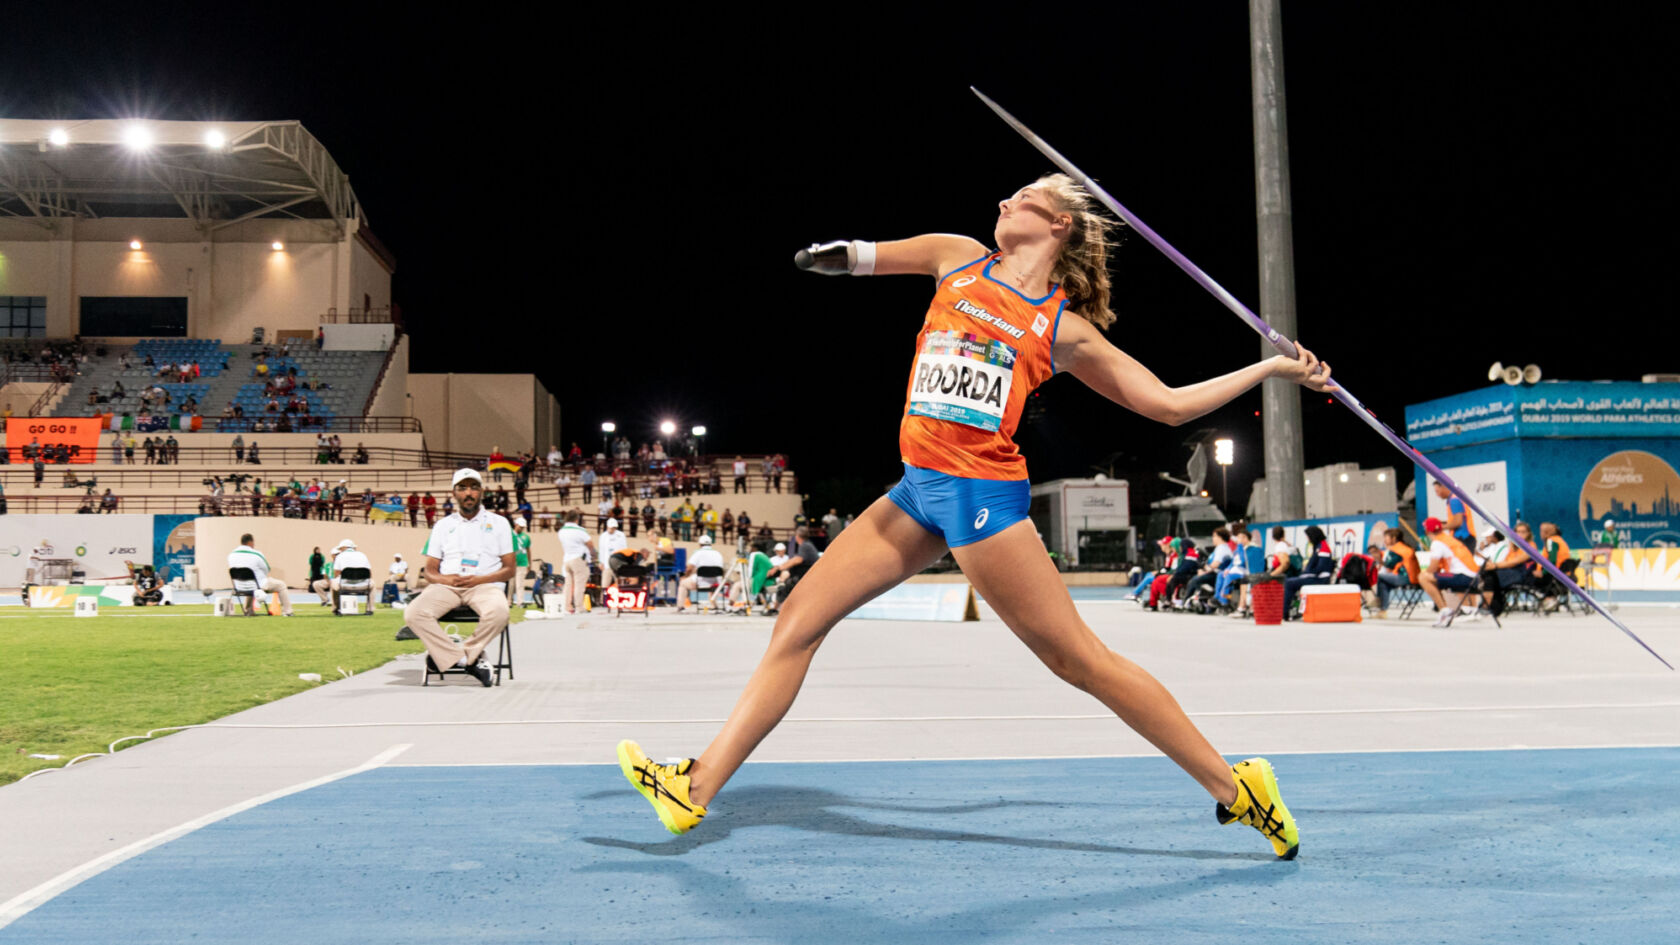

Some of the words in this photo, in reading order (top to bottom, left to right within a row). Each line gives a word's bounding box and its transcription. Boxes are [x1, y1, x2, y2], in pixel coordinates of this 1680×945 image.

[915, 362, 1003, 408] ROORDA
[1522, 414, 1549, 423] DUBAI
[1572, 414, 1602, 423] WORLD
[1604, 414, 1626, 423] PARA
[1628, 414, 1672, 423] ATHLETICS
[28, 425, 46, 434] GO
[49, 424, 67, 434] GO
[1614, 521, 1669, 529] AMPIONSHIPS
[1591, 530, 1631, 542] DAI
